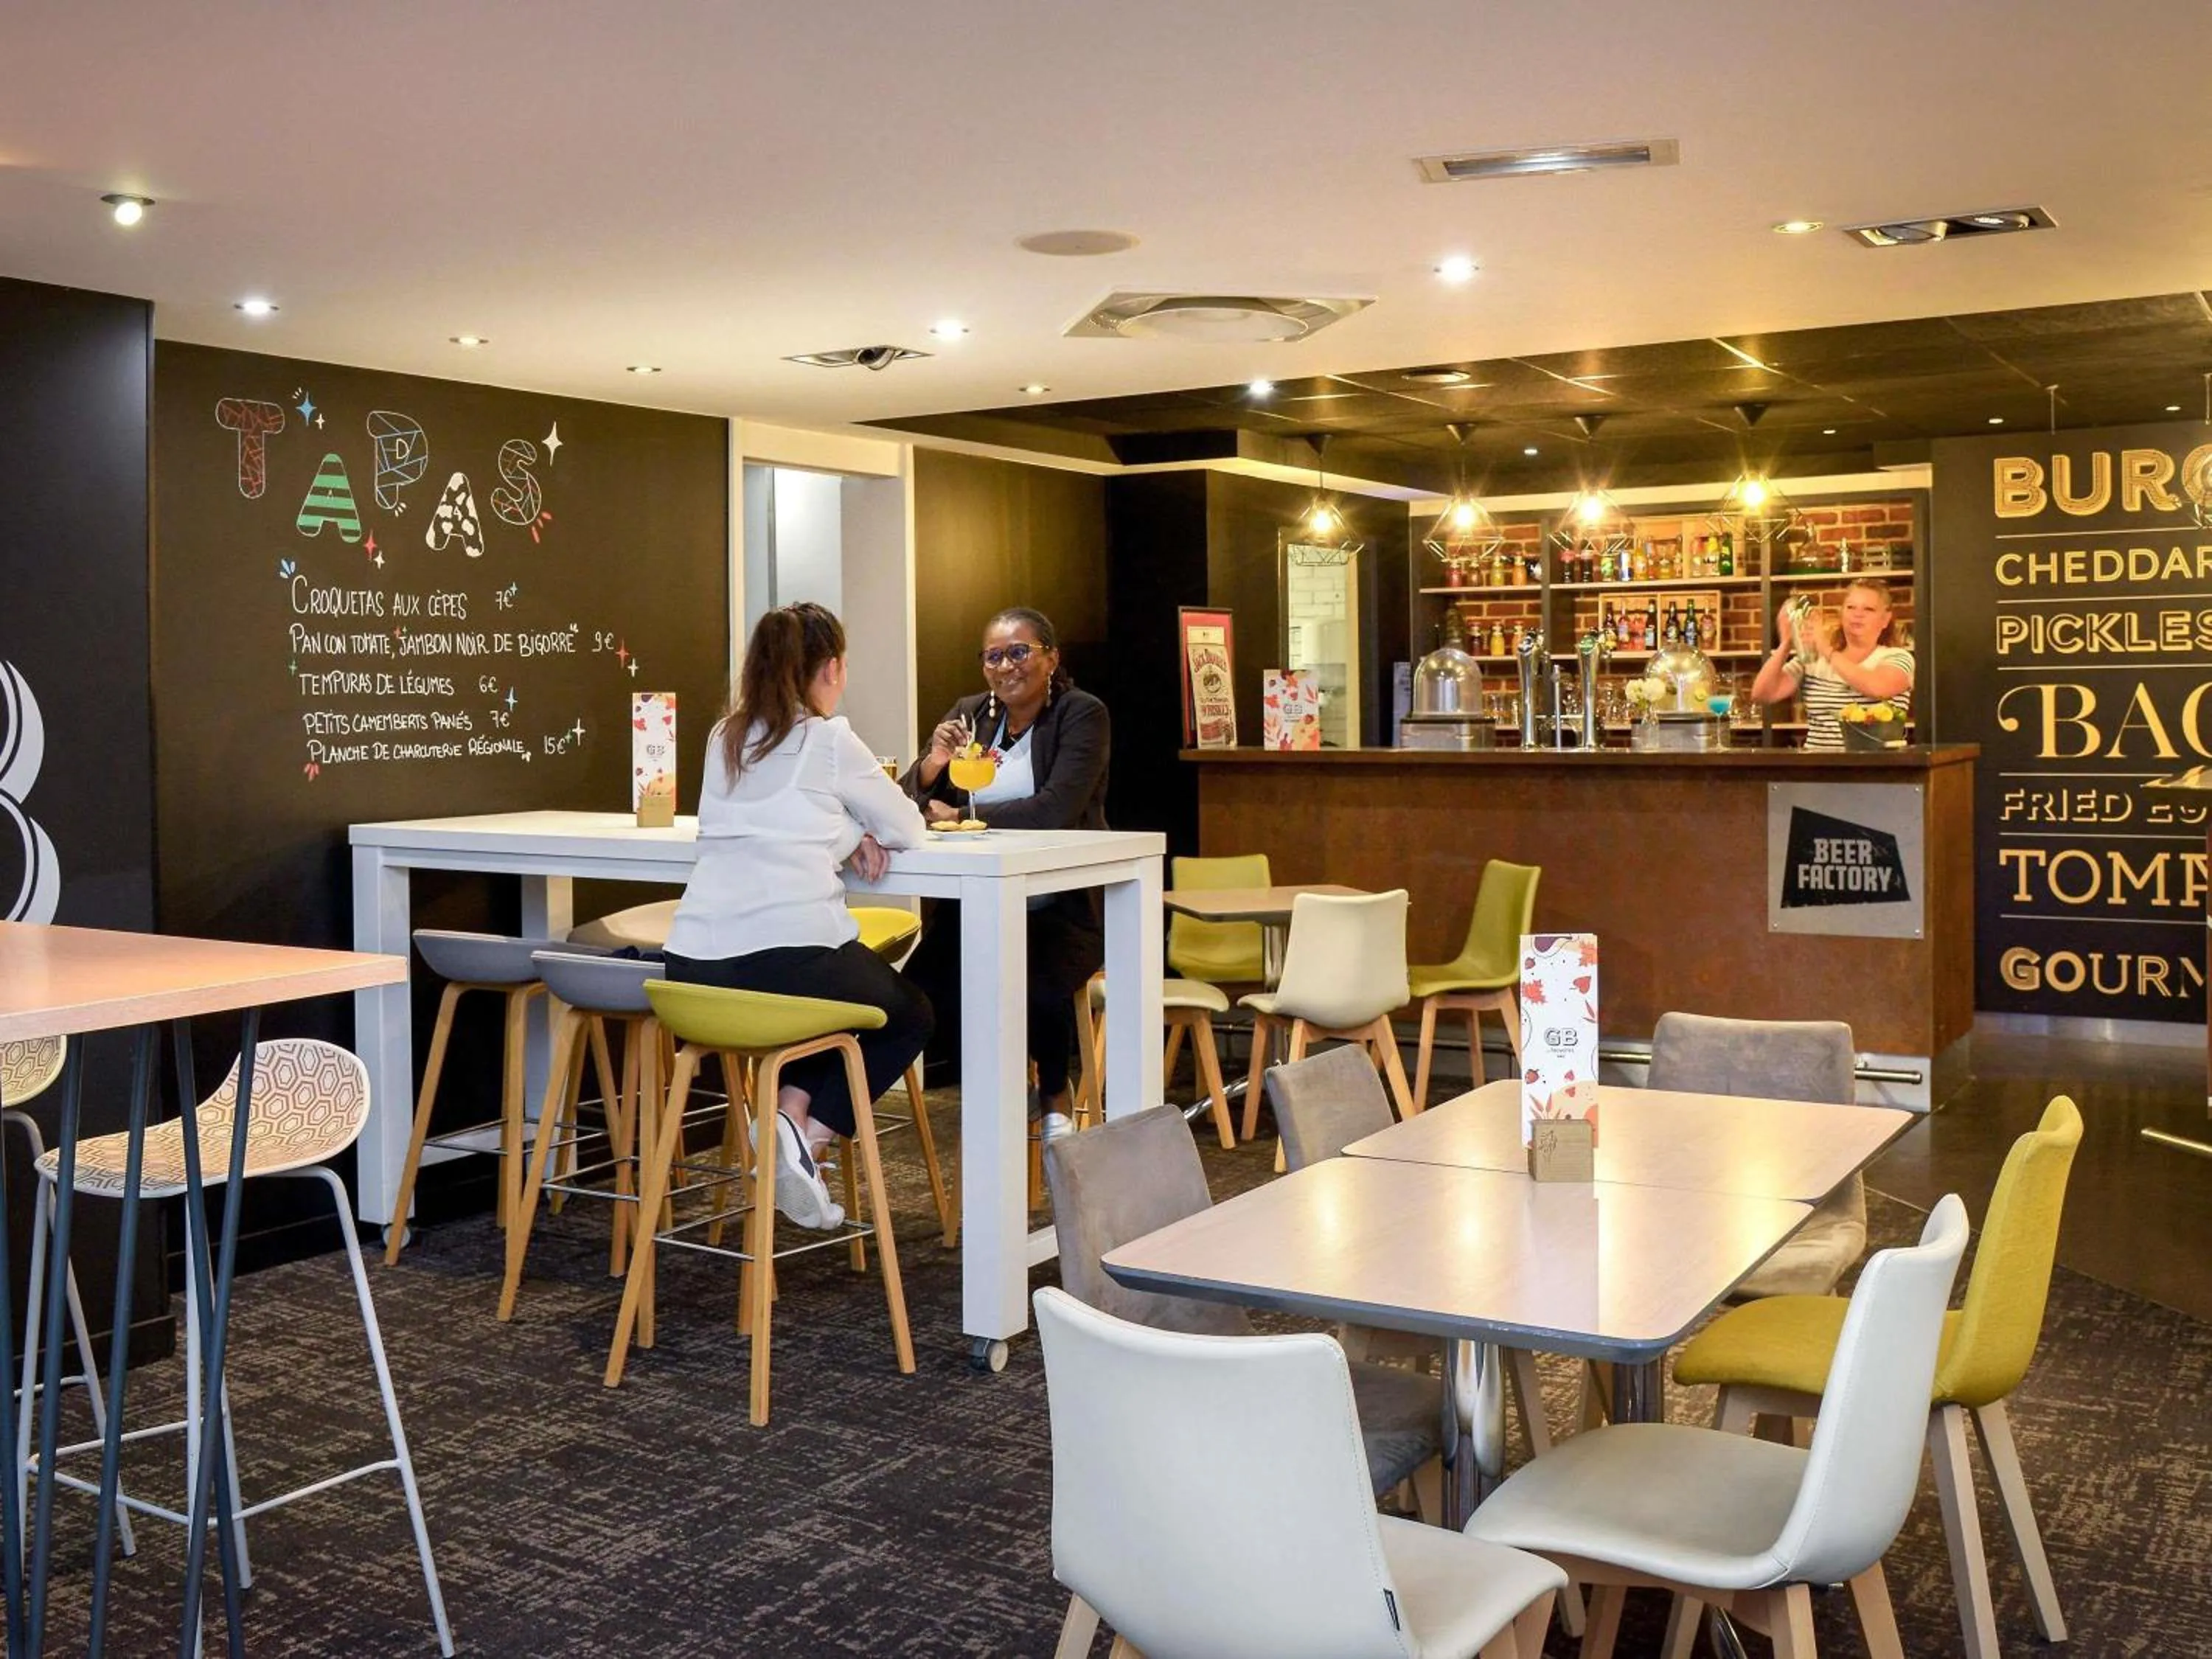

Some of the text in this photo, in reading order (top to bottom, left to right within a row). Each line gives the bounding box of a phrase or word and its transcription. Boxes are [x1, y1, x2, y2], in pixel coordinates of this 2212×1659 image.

[215, 397, 542, 557] TAPAS
[1995, 546, 2212, 586] CHEDDAR
[292, 574, 384, 617] CROQUETAS
[393, 592, 420, 616] AUX
[495, 590, 514, 611] 7€
[289, 623, 321, 654] PAN
[324, 633, 347, 655] CON
[398, 633, 451, 655] JAMBON
[494, 633, 513, 653] DE
[592, 630, 614, 653] 9€
[1996, 611, 2212, 655] PICKLES
[299, 669, 498, 696] TEMPURAS DE LÉGUMES 6€
[352, 712, 428, 732] CAMEMBERTS
[431, 710, 472, 731] PANÉS
[490, 710, 510, 728] 7€
[307, 740, 369, 764] PLANCHE
[372, 742, 390, 759] DE
[543, 735, 566, 755] 15€
[2000, 788, 2132, 823] FRIED
[1813, 838, 1872, 864] BEER
[1798, 863, 1892, 892] FACTORY
[1544, 1027, 1579, 1046] GB
